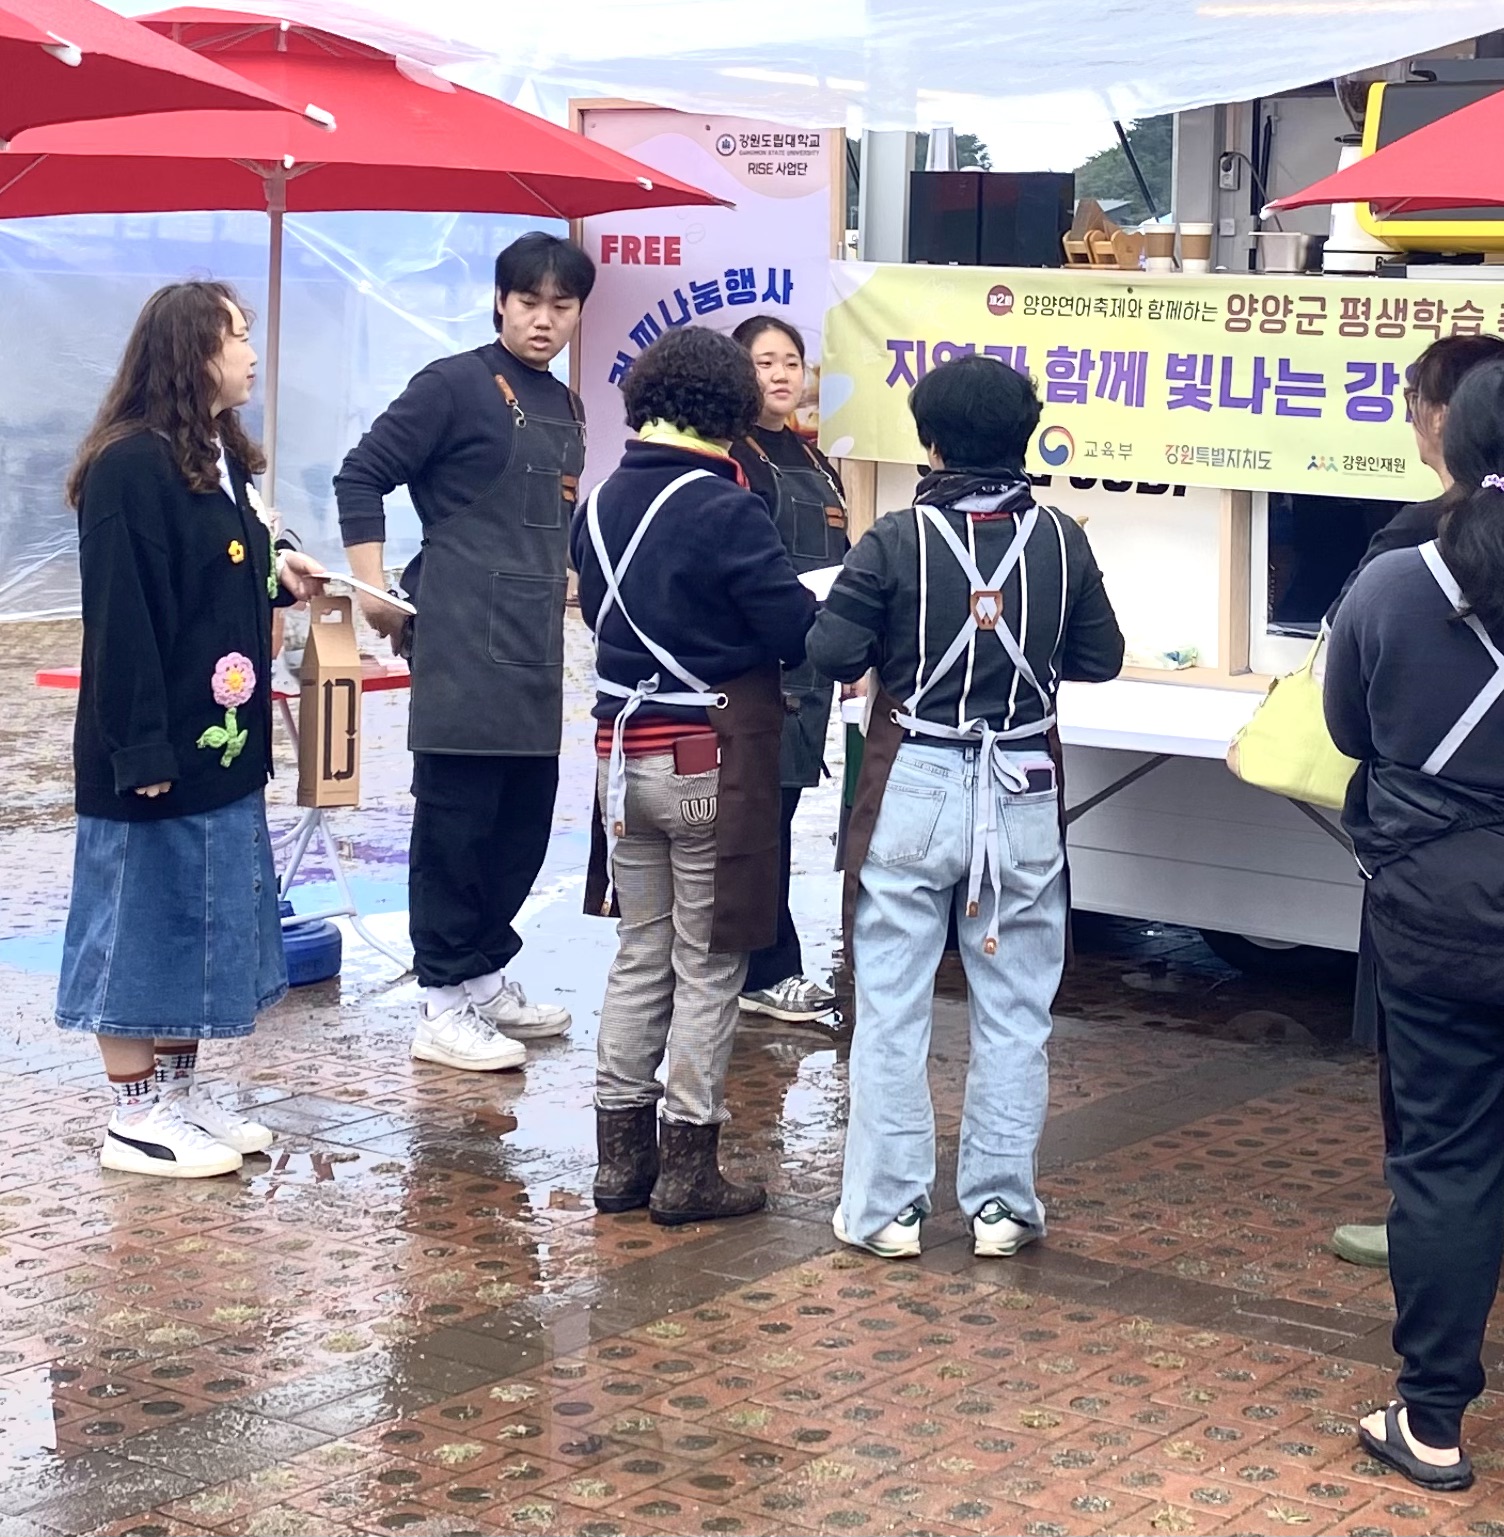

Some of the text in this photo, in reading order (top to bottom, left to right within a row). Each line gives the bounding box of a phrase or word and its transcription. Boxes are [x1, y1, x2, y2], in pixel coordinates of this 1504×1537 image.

[739, 134, 820, 148] 강원도립대학교
[748, 162, 808, 175] RISE 사업단
[601, 235, 681, 266] FREE
[1023, 295, 1143, 319] 양양연어축제와
[1148, 299, 1218, 322] 함께하는
[1225, 293, 1328, 336] 양양군
[1338, 297, 1485, 340] 평생학습
[1045, 346, 1149, 408] 함께
[1166, 353, 1327, 418] 빛나는
[1084, 441, 1406, 473] 교육부 강원특별자치도 강원인재원
